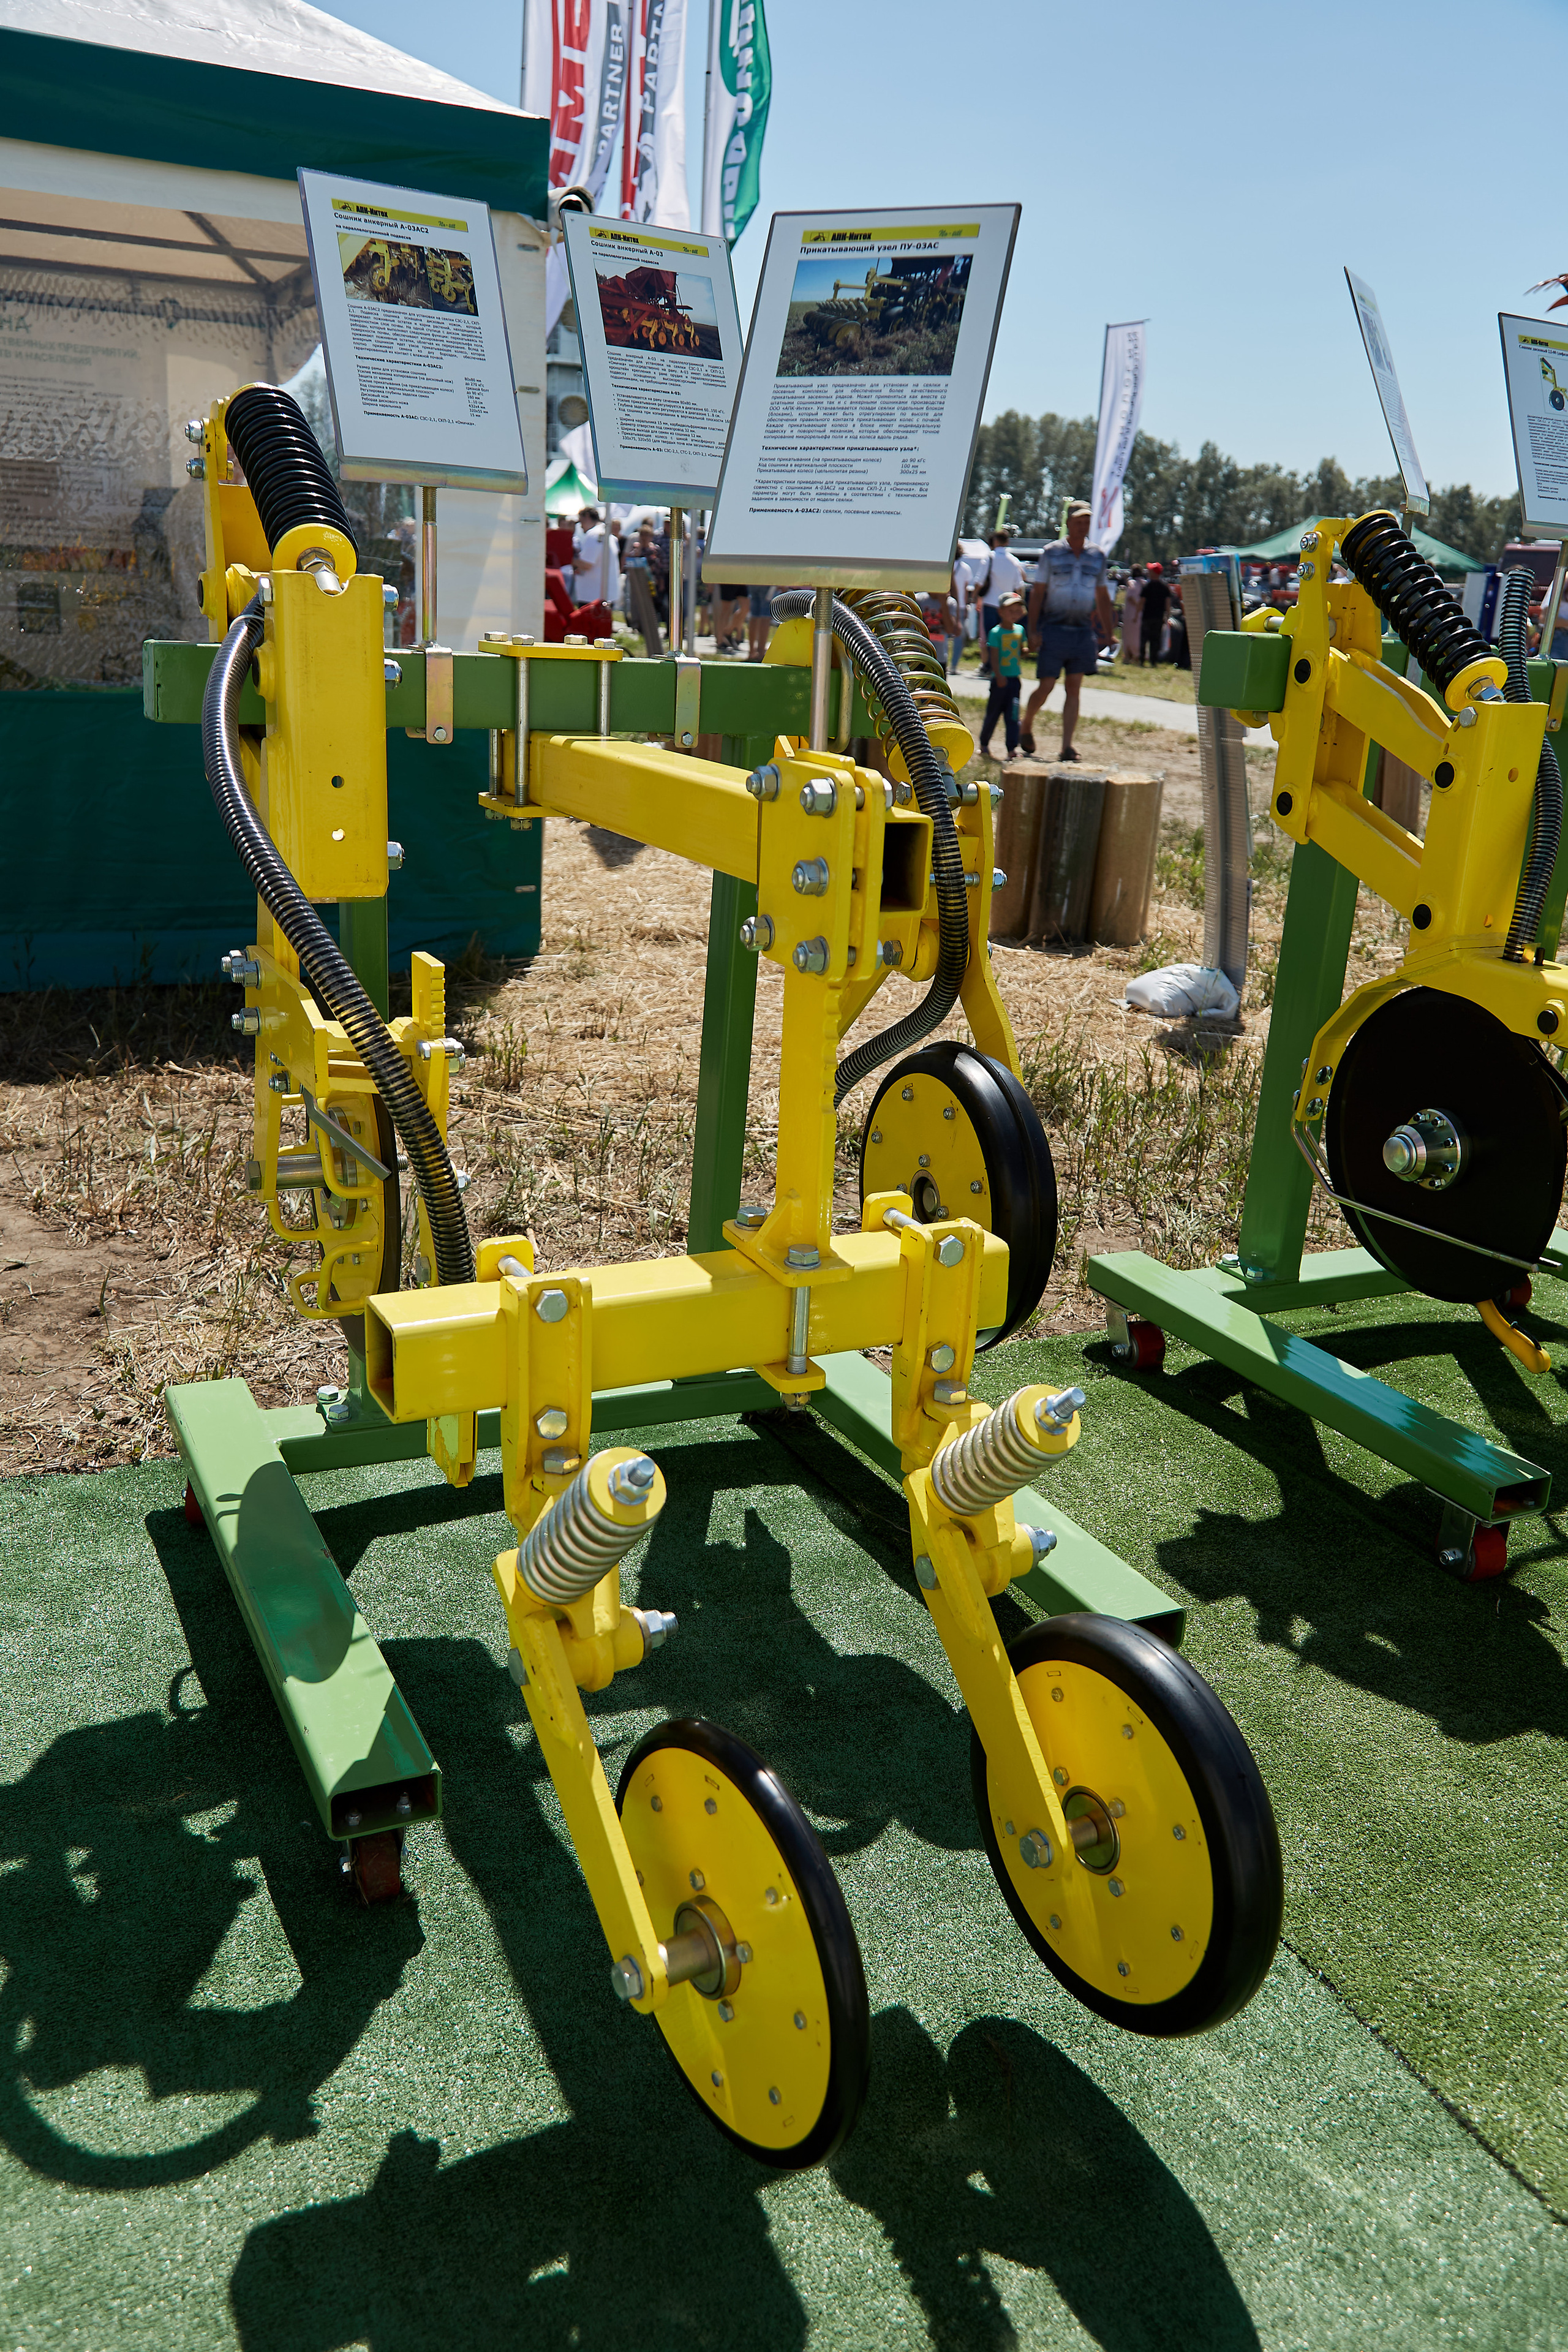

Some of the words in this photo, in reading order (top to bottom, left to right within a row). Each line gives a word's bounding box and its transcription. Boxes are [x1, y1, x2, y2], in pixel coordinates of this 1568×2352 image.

[598, 23, 624, 155] PARTNER
[356, 205, 389, 217] АПК-Интех
[611, 233, 639, 244] АПК-Интех
[831, 232, 872, 241] АПК-Интех
[799, 244, 875, 254] Прикатывающий
[899, 241, 939, 250] ПУ-03АС
